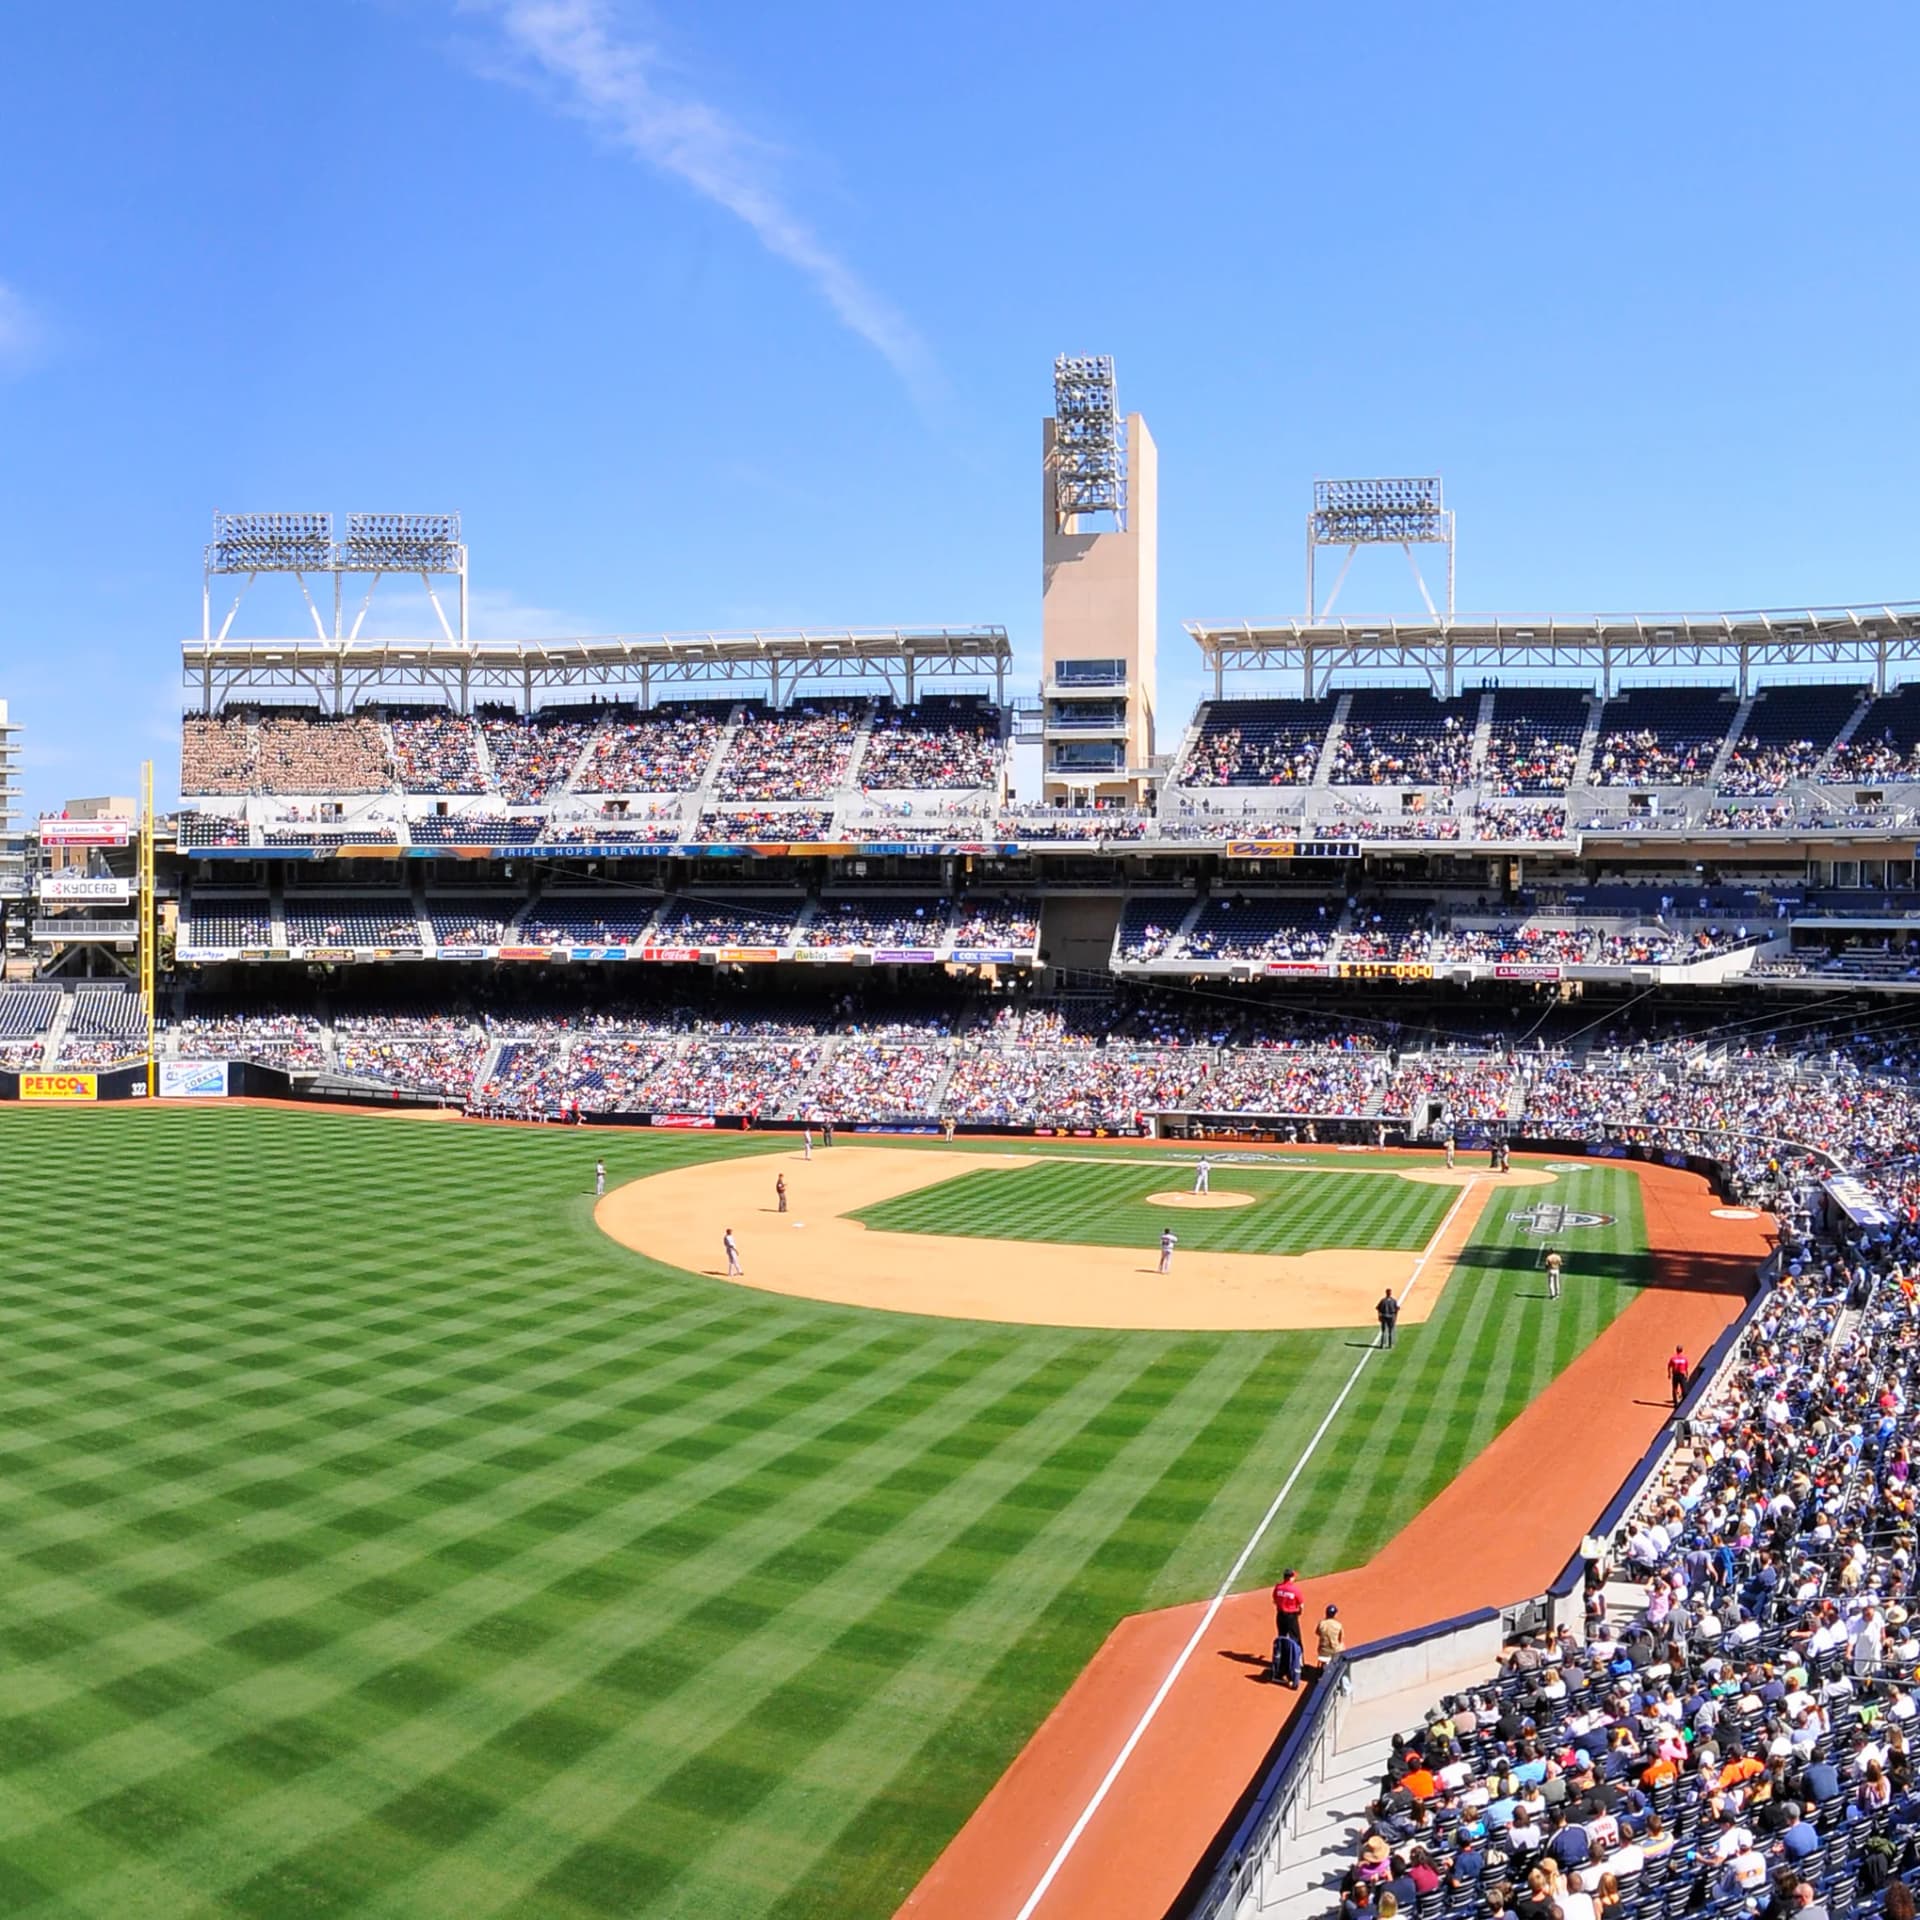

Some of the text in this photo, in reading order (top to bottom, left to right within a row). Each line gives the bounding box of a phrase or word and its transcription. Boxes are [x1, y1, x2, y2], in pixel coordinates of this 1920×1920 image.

[500, 847, 660, 856] TRIPLE HOPS BREWED
[859, 844, 934, 855] MILLER LITE
[1301, 844, 1355, 856] PIZZA
[25, 1077, 79, 1090] PETCO
